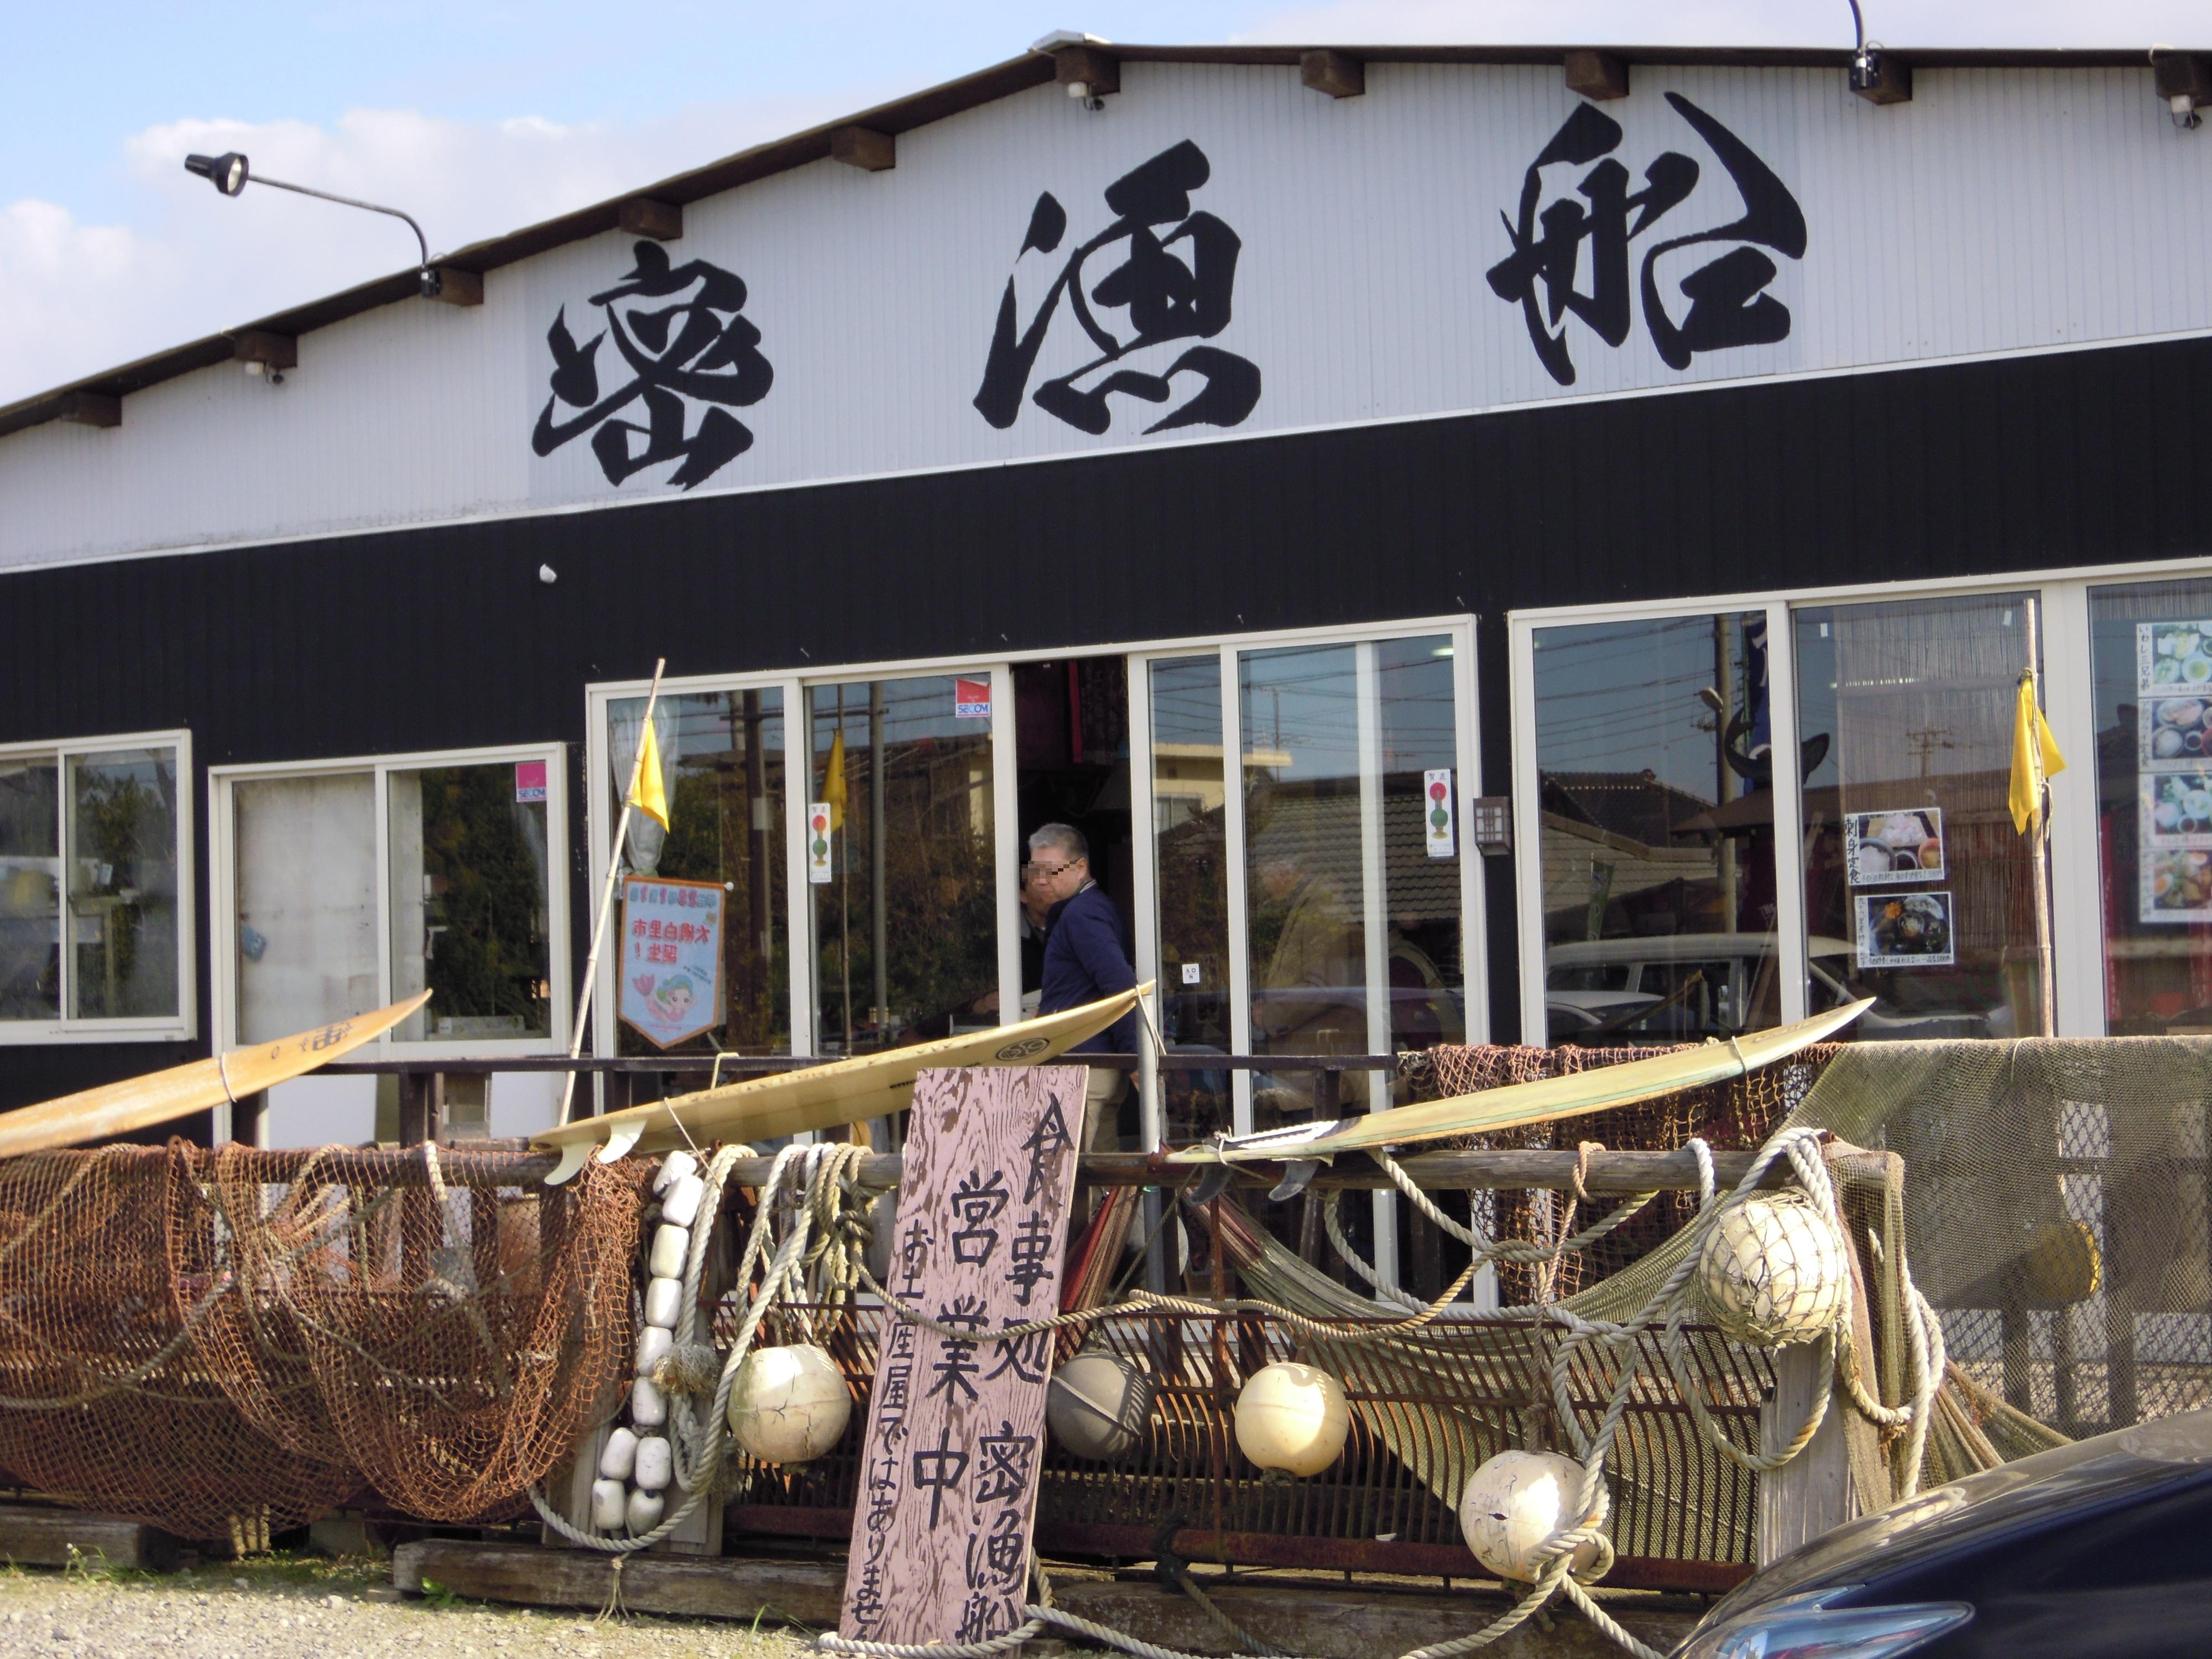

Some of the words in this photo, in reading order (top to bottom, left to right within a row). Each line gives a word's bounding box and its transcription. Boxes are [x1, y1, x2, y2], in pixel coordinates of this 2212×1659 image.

[958, 704, 988, 713] SECOM
[518, 789, 546, 798] SECOM
[1845, 818, 1861, 884] 刺身定食
[913, 1170, 1010, 1531] 営業中
